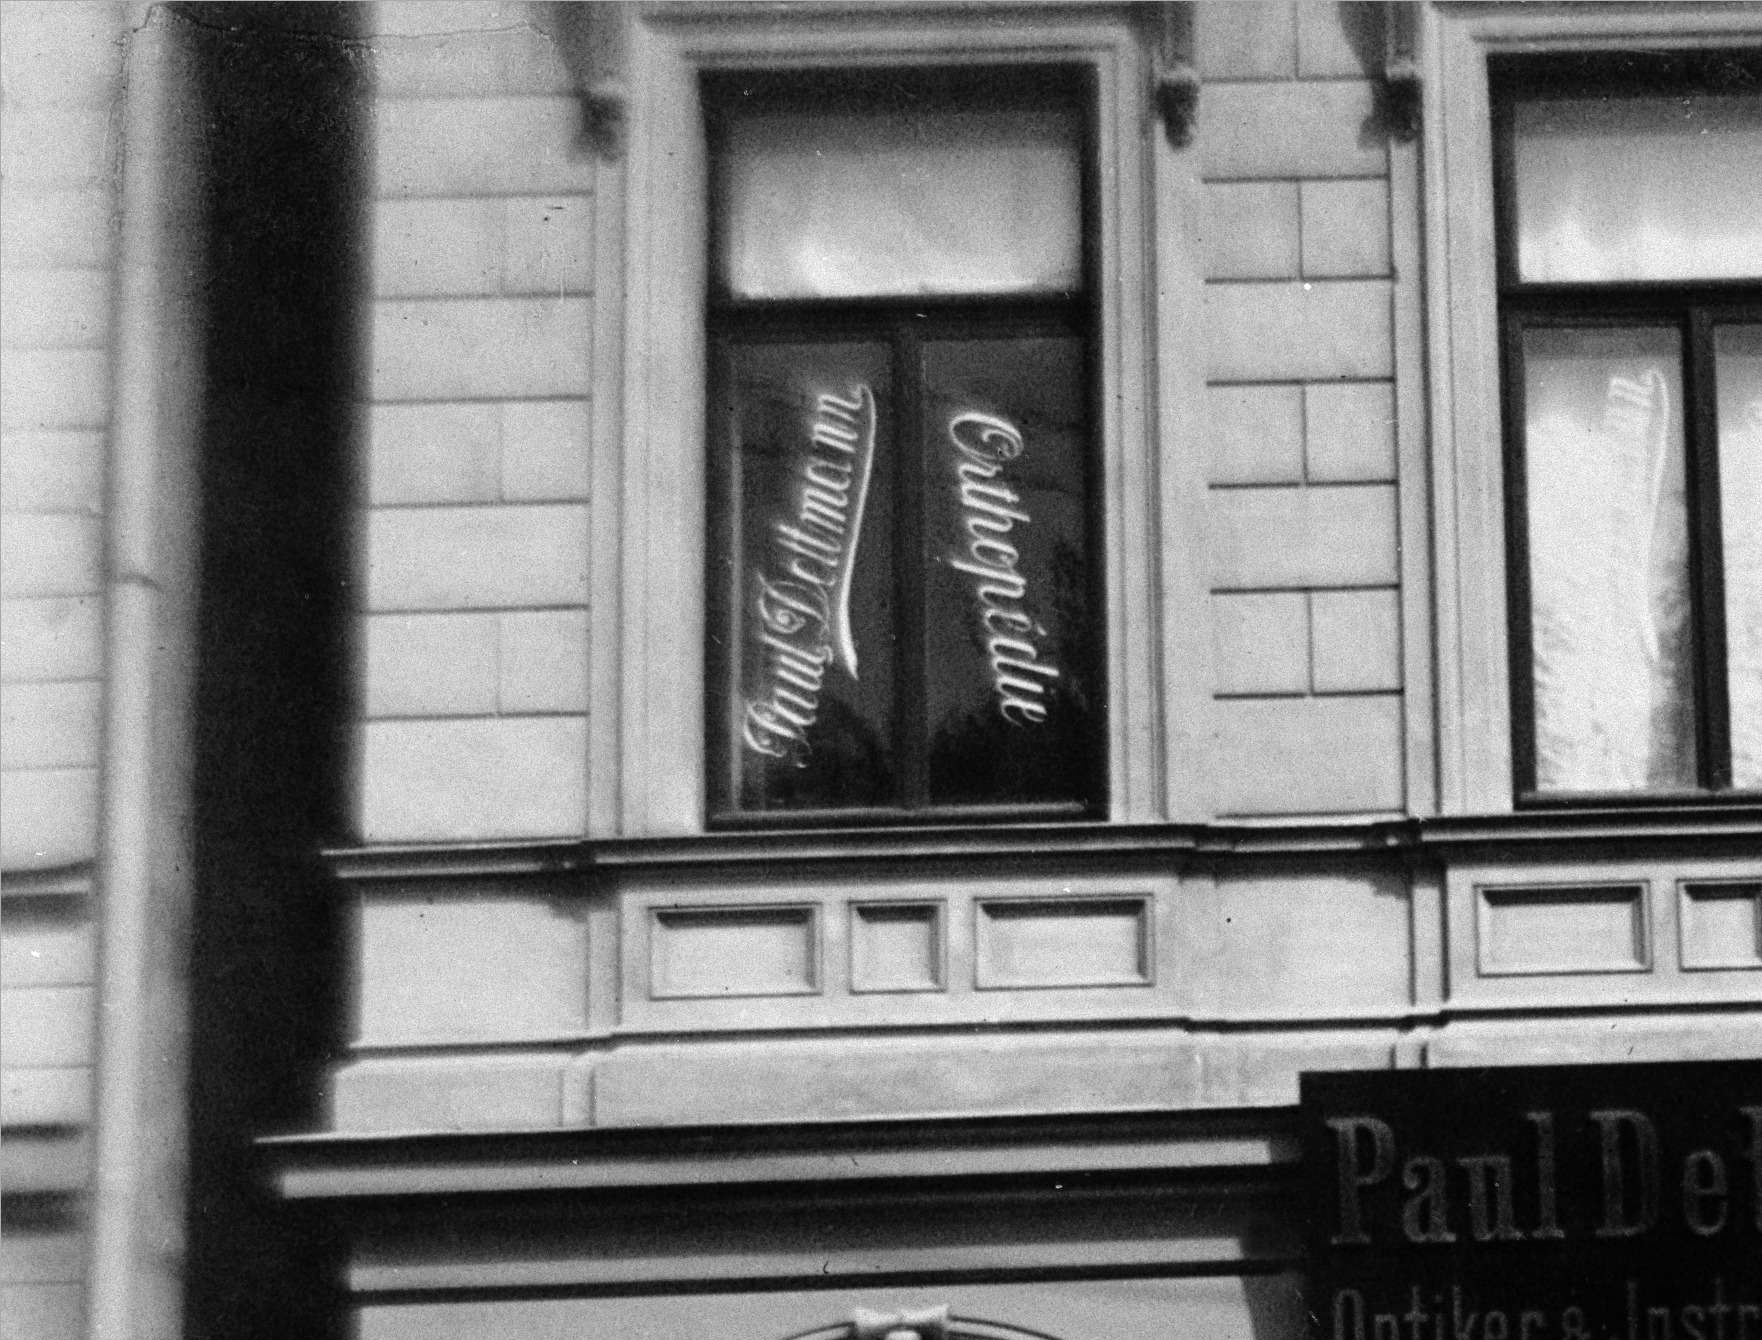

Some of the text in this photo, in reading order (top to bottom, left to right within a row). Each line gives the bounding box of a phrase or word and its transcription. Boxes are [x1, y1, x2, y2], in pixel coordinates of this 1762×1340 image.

[743, 384, 872, 767] Paul Dettmann
[1326, 1112, 1566, 1246] Paul
